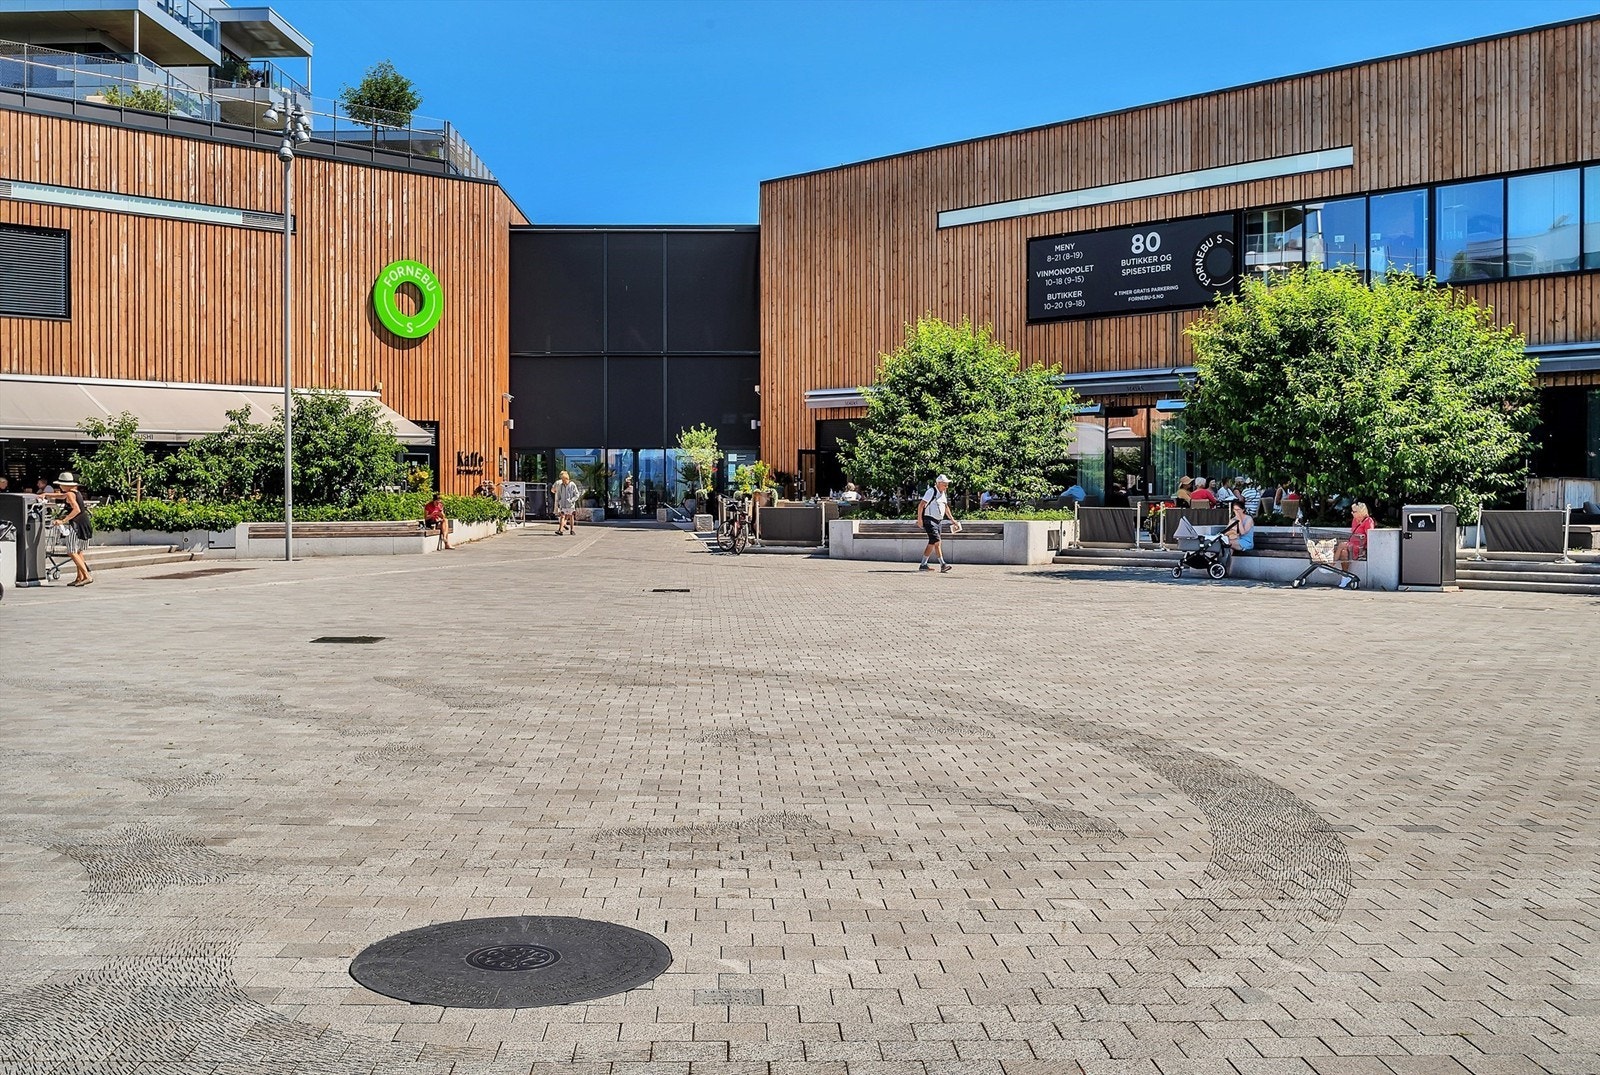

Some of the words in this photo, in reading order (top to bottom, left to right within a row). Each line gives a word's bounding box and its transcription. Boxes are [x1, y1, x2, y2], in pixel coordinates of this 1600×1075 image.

[1055, 243, 1075, 251] MENY
[1131, 232, 1161, 254] 80
[1046, 253, 1061, 262] 8-21
[1062, 251, 1083, 261] (8-19)
[1121, 256, 1158, 266] BUTIKKER
[1160, 254, 1172, 262] OG
[1195, 238, 1214, 287] FORNEBU
[1216, 235, 1222, 244] S
[1036, 265, 1094, 278] VINMONOPOLET
[1121, 264, 1171, 276] SPISESTEDER
[384, 266, 436, 292] FORNEBU
[1045, 277, 1062, 286] 10-18
[1064, 275, 1084, 285] (9-15)
[1151, 284, 1179, 293] PARKERING
[1047, 290, 1082, 300] BUTIKKER
[1128, 293, 1164, 302] FORNEBU-S.NO
[1044, 301, 1064, 310] 10-20
[1065, 299, 1085, 309] (9-18)
[406, 323, 413, 333] S
[456, 451, 484, 467] Kaffe
